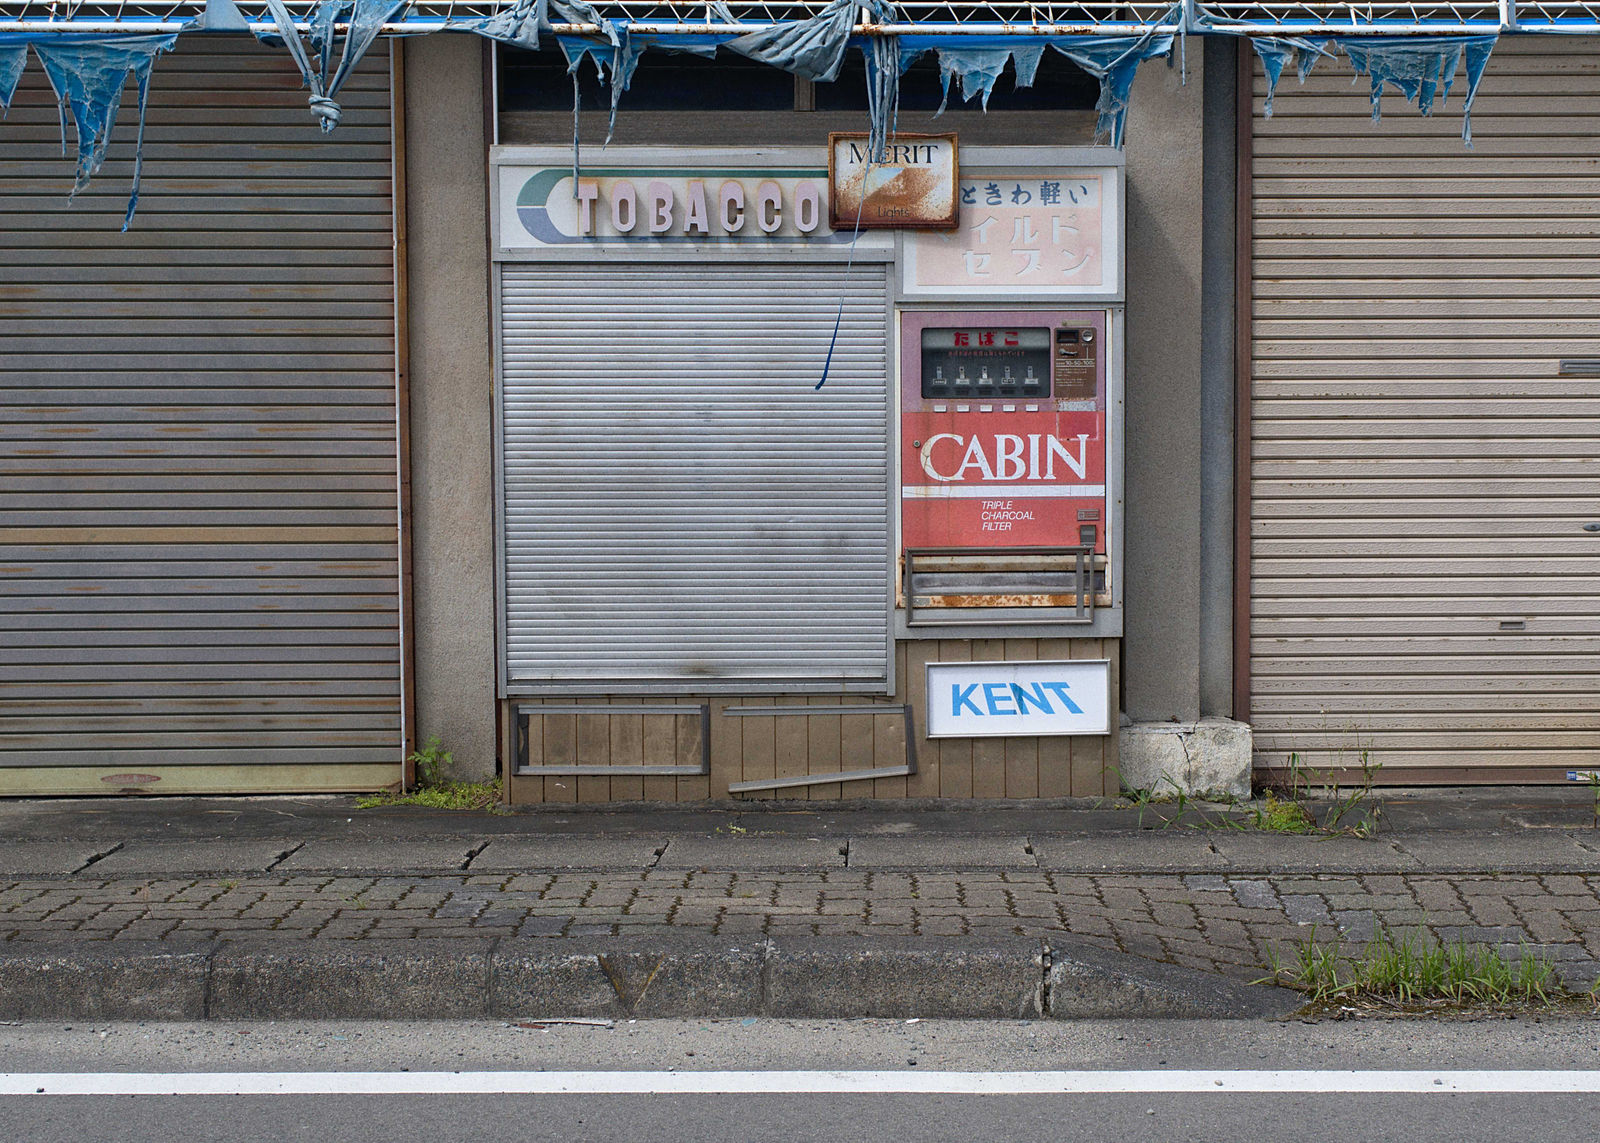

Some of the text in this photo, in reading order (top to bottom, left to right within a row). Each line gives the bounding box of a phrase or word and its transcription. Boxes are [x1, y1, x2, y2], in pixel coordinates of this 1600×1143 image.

[577, 180, 820, 233] TOBACCO
[877, 203, 911, 218] Lights
[936, 214, 1080, 245] イルド
[962, 248, 1093, 277] セブン
[954, 330, 1019, 347] たばこ
[920, 433, 1090, 482] CABIN
[981, 500, 1013, 510] TRIPLE
[981, 511, 1036, 520] CHARCOAL
[982, 521, 1013, 531] FILTER
[952, 681, 1085, 716] KENT
